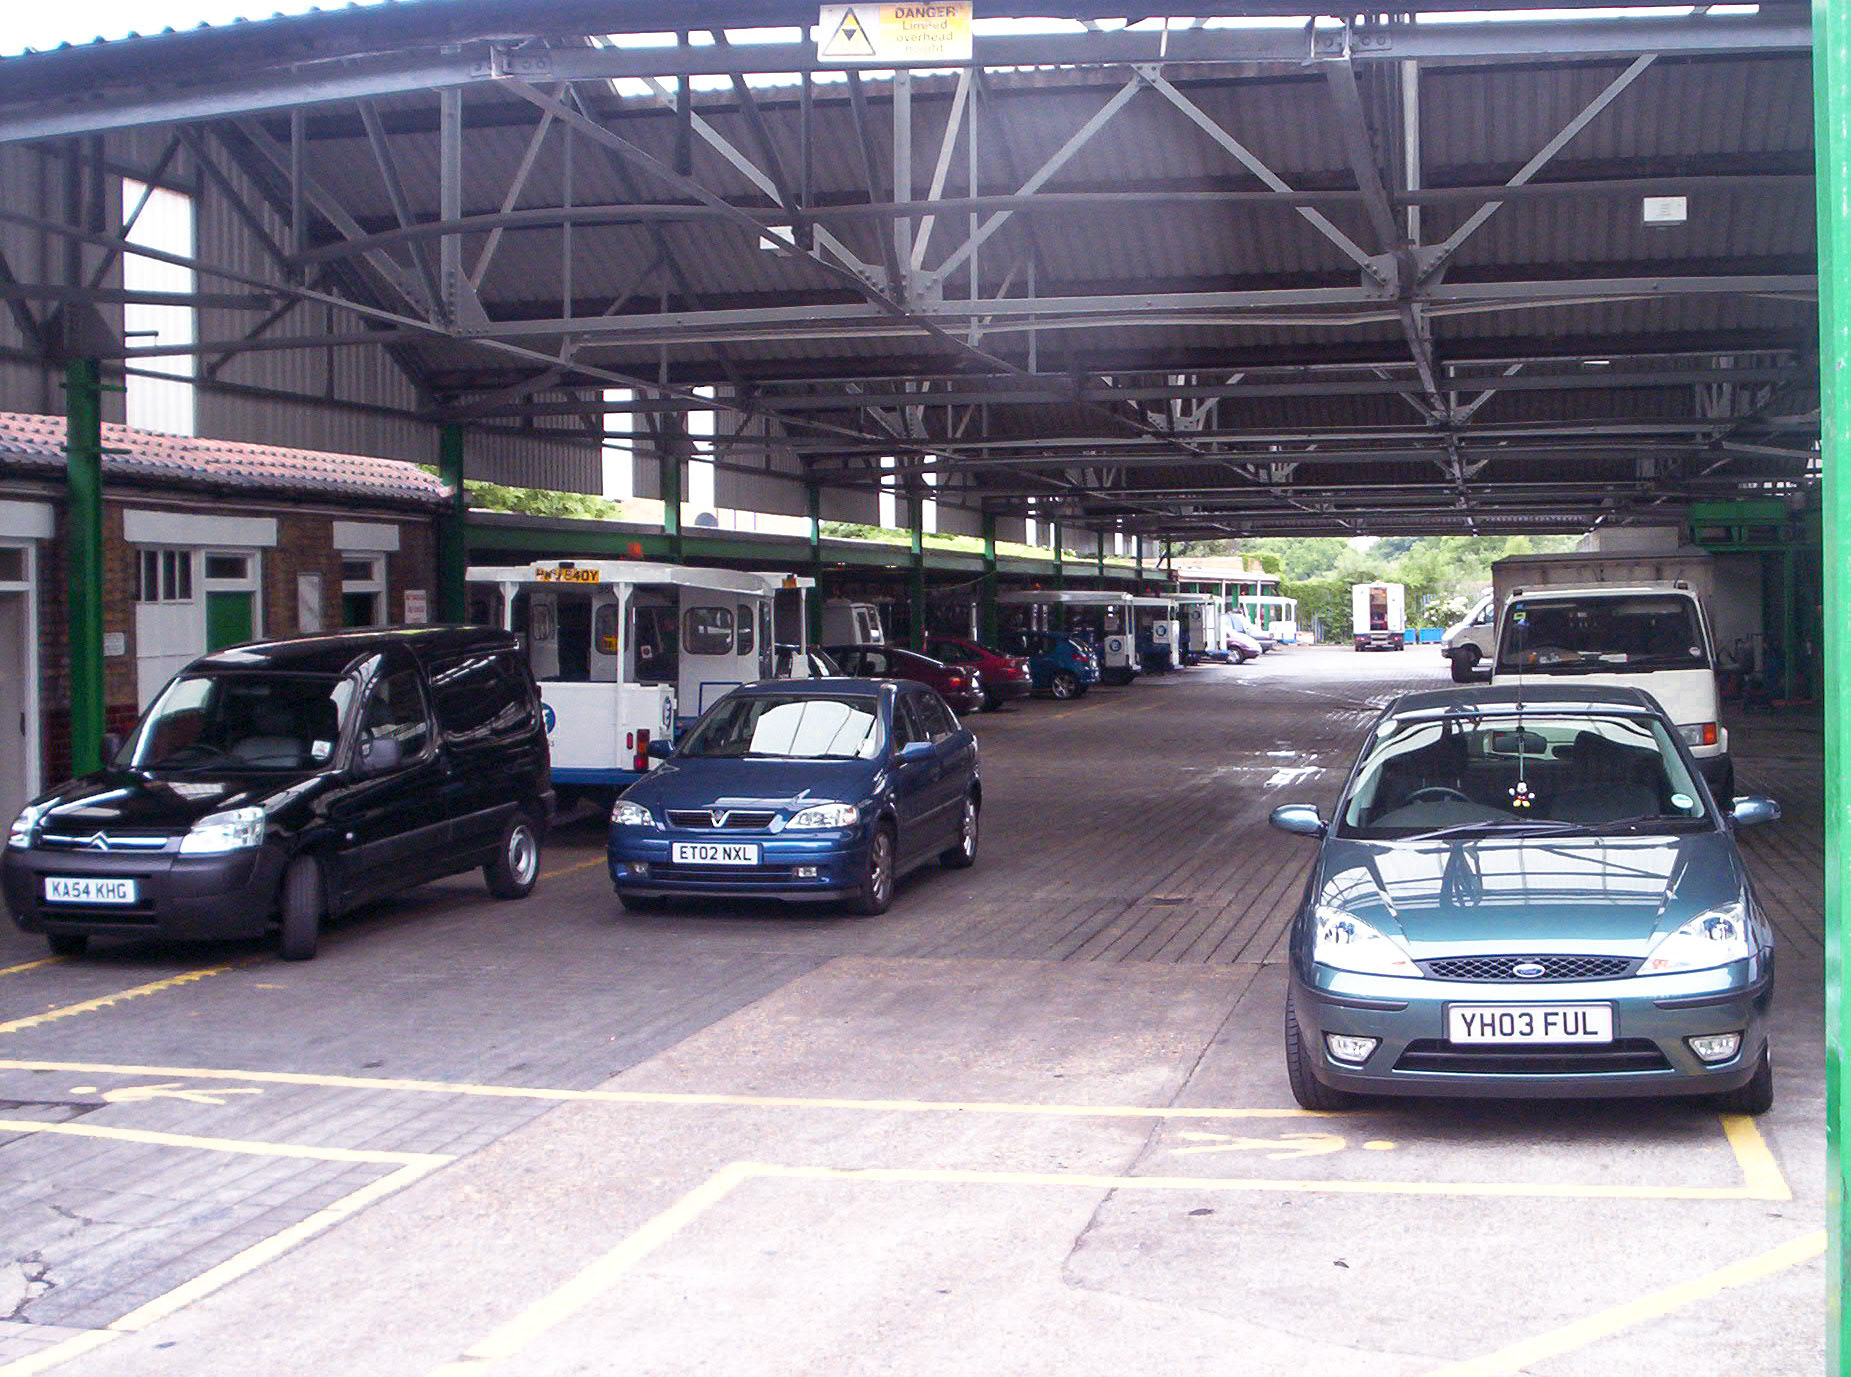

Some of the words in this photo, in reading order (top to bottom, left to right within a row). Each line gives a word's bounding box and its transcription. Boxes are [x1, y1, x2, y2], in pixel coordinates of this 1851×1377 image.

[895, 6, 956, 18] DANGER
[902, 19, 948, 31] Limited
[896, 32, 953, 42] overhead
[680, 845, 718, 860] ET02
[722, 846, 752, 861] NXL
[52, 881, 90, 898] KA54
[95, 882, 127, 899] KHG
[1461, 1012, 1534, 1037] YH03
[1543, 1011, 1599, 1036] FUL
